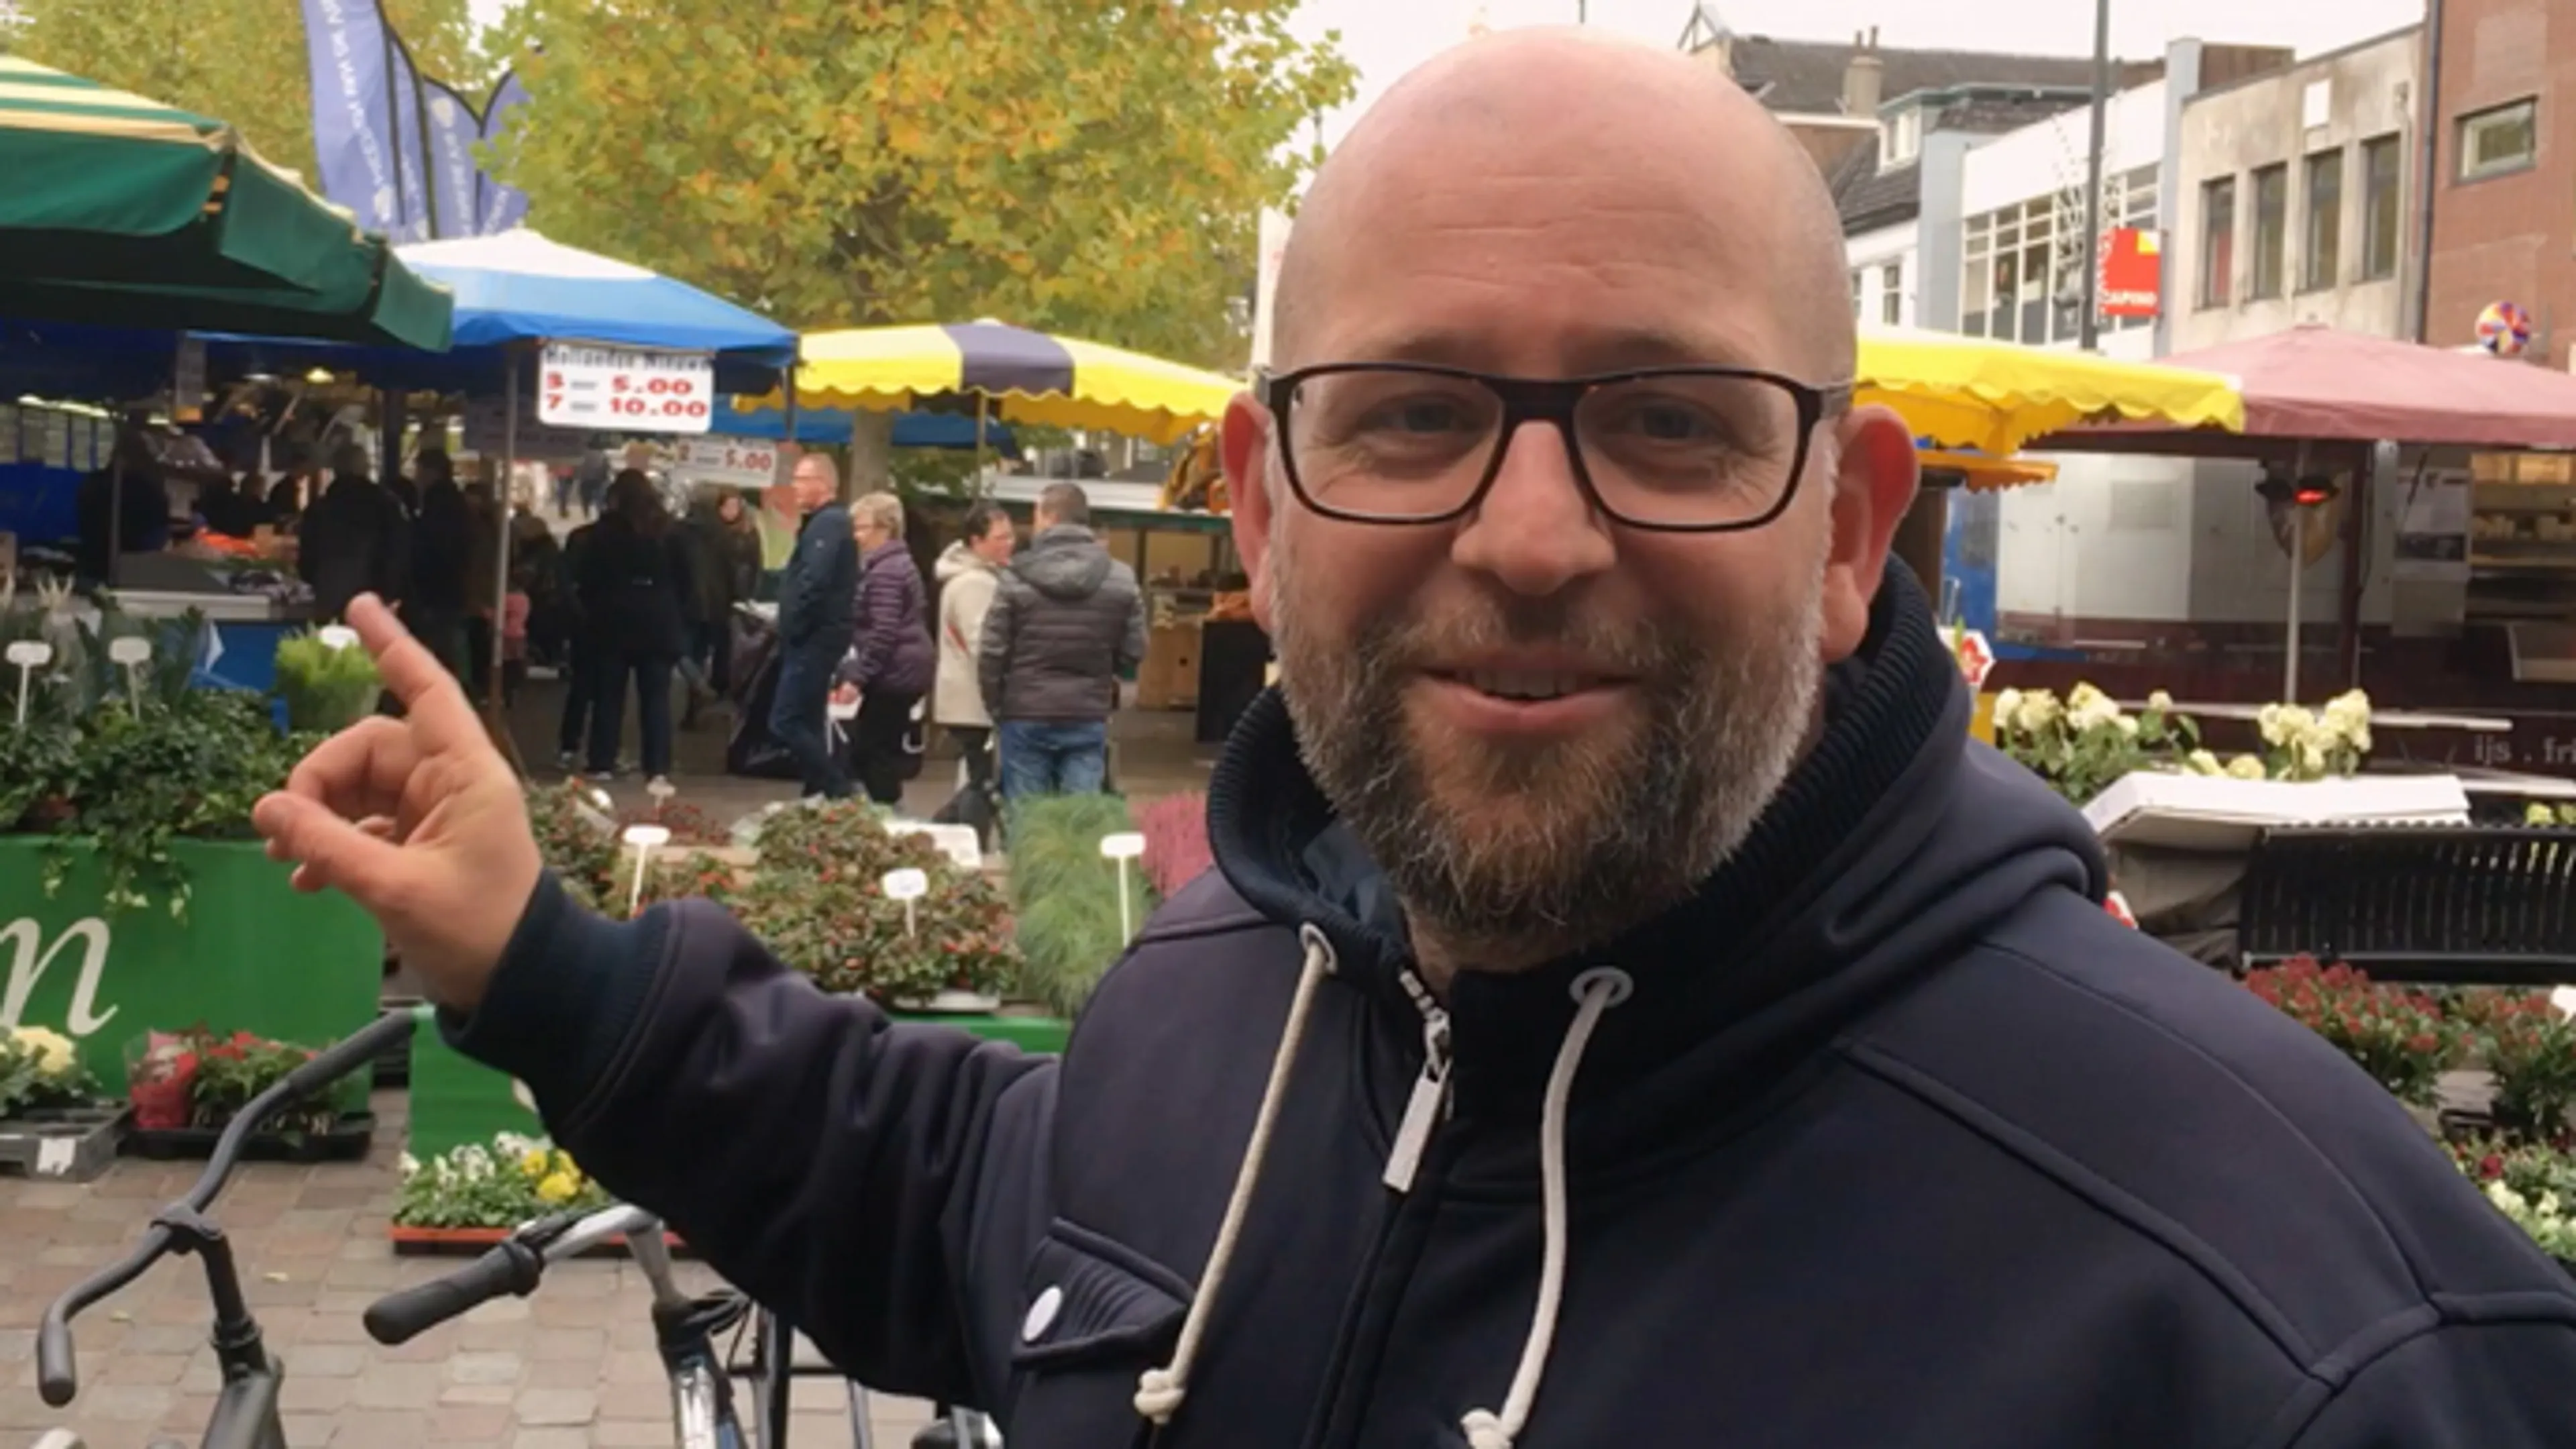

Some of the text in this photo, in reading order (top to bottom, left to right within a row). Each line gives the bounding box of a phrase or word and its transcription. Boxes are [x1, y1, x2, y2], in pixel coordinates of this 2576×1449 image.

[547, 372, 564, 390] 3
[611, 376, 692, 395] 5.00
[547, 394, 562, 410] 7
[609, 397, 707, 417] 10.00
[2474, 734, 2512, 767] ijs
